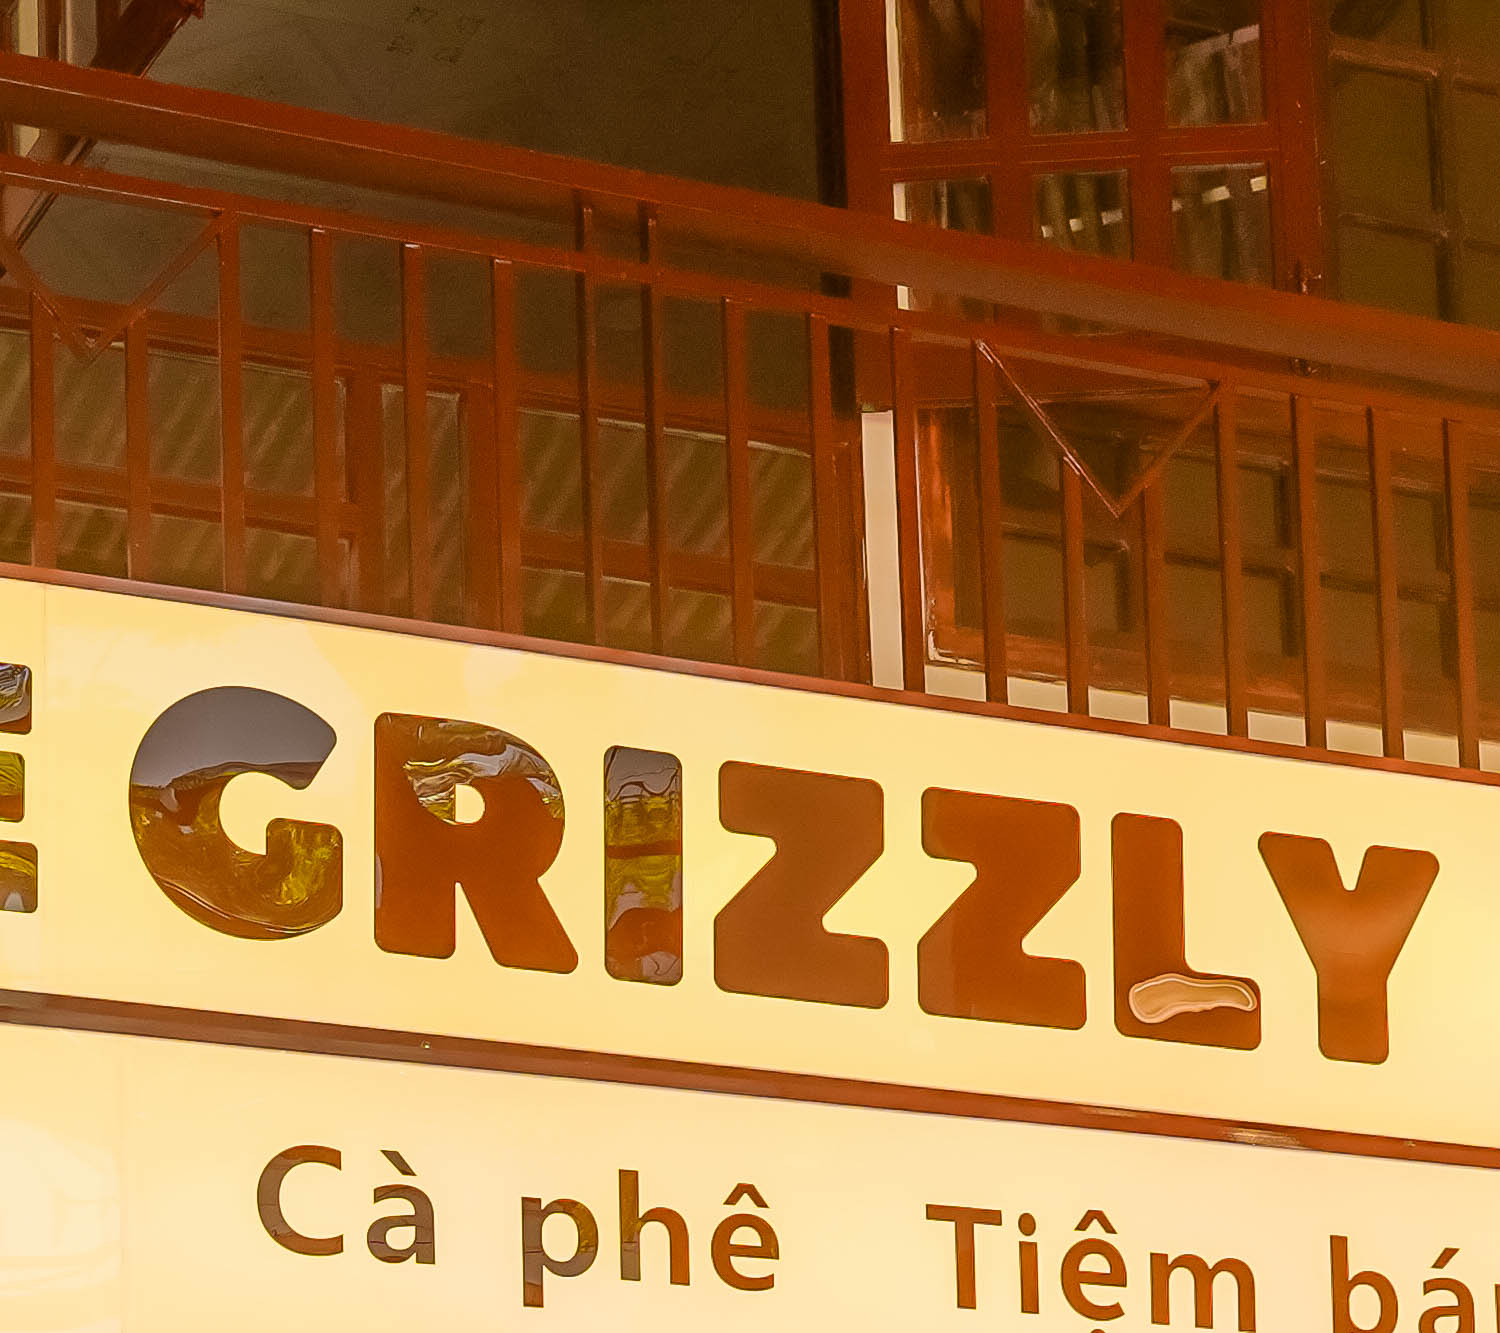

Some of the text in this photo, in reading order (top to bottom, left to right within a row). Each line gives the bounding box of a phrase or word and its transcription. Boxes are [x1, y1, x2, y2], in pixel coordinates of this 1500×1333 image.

[128, 685, 1441, 1066] GRIZZLY
[256, 1143, 437, 1265] Cà
[520, 1167, 781, 1310] phê
